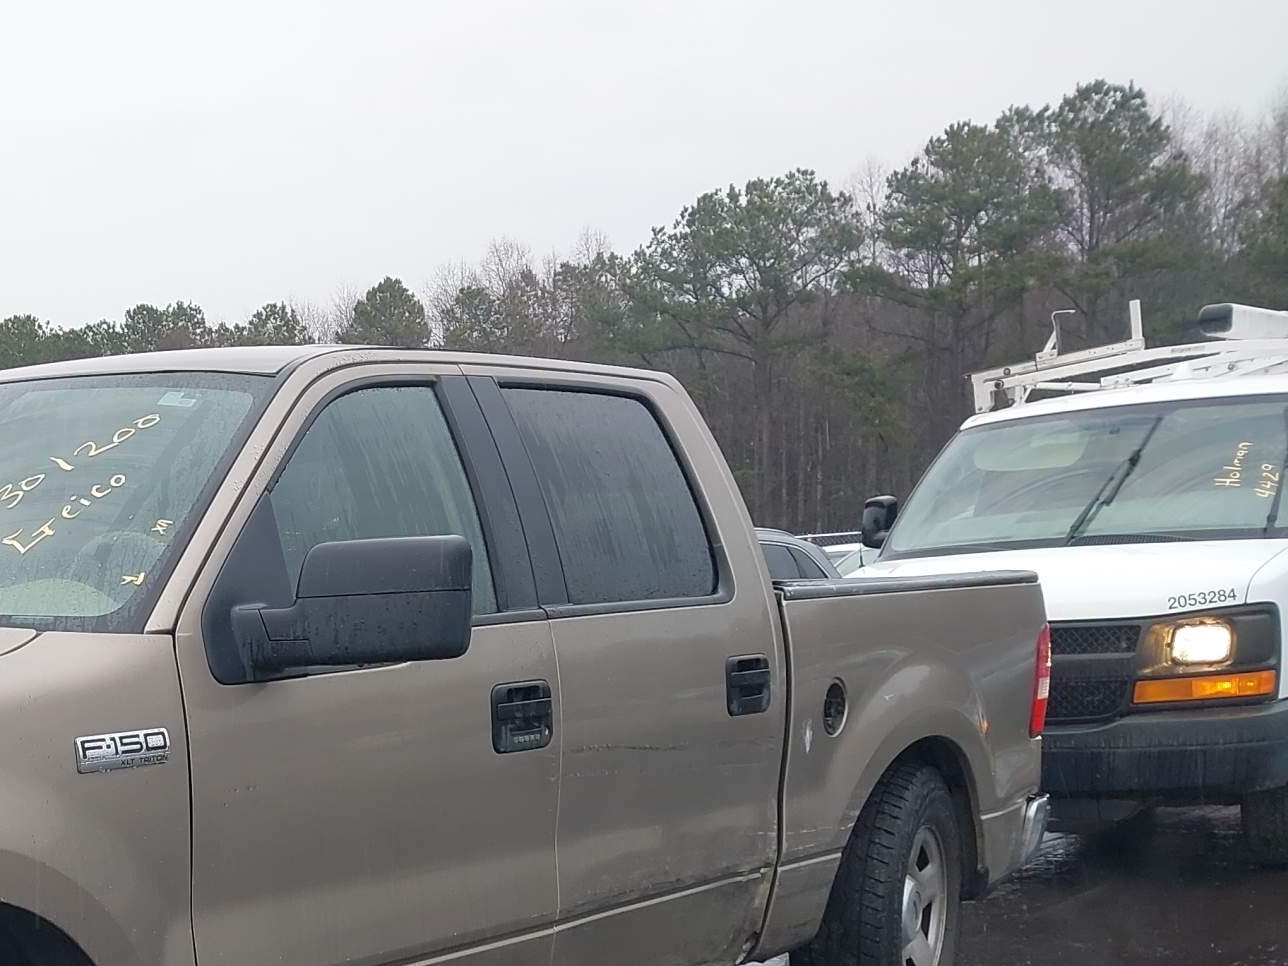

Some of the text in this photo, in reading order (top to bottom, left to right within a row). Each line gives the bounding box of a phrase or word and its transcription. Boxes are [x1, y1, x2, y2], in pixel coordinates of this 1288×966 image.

[1213, 442, 1254, 487] Holman
[1254, 463, 1279, 498] 4429
[1167, 587, 1237, 610] 2053284
